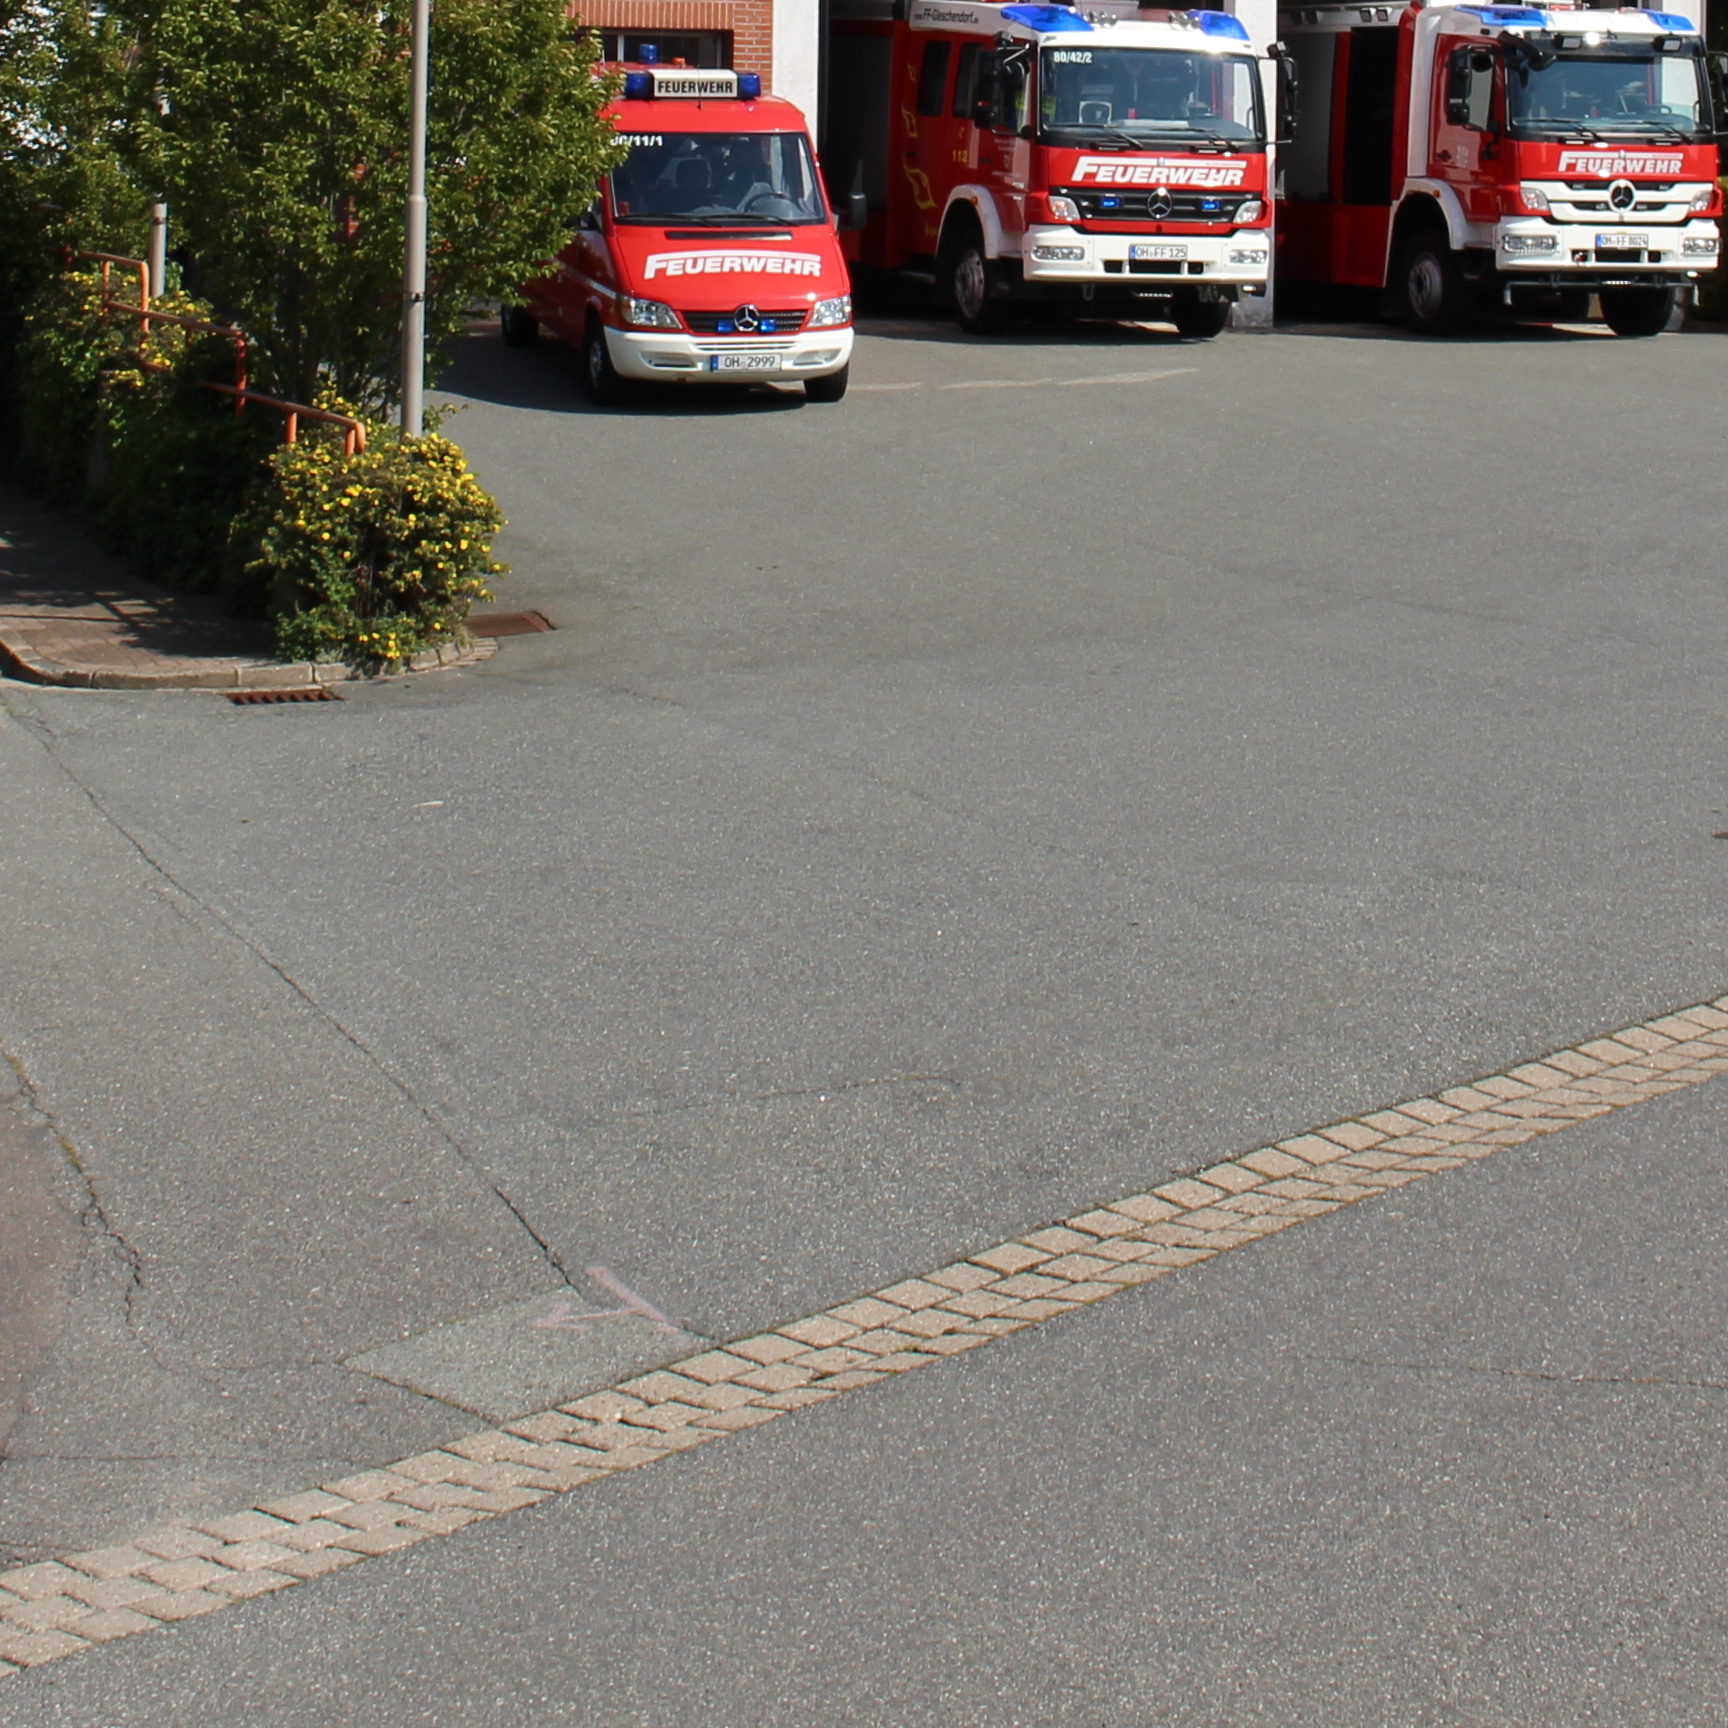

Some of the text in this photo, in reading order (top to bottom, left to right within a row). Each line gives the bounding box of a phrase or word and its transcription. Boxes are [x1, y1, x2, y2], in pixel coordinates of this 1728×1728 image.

[1053, 51, 1092, 63] 80/42/2
[657, 80, 733, 94] FEUERWEHR
[952, 149, 968, 163] 112
[1558, 151, 1684, 174] FEUERWEHR
[1071, 156, 1248, 187] FEUERWEHR
[1154, 247, 1166, 257] FF
[1169, 248, 1186, 258] 125
[644, 249, 822, 279] FEUERWEHR
[724, 356, 775, 367] OH 2999
